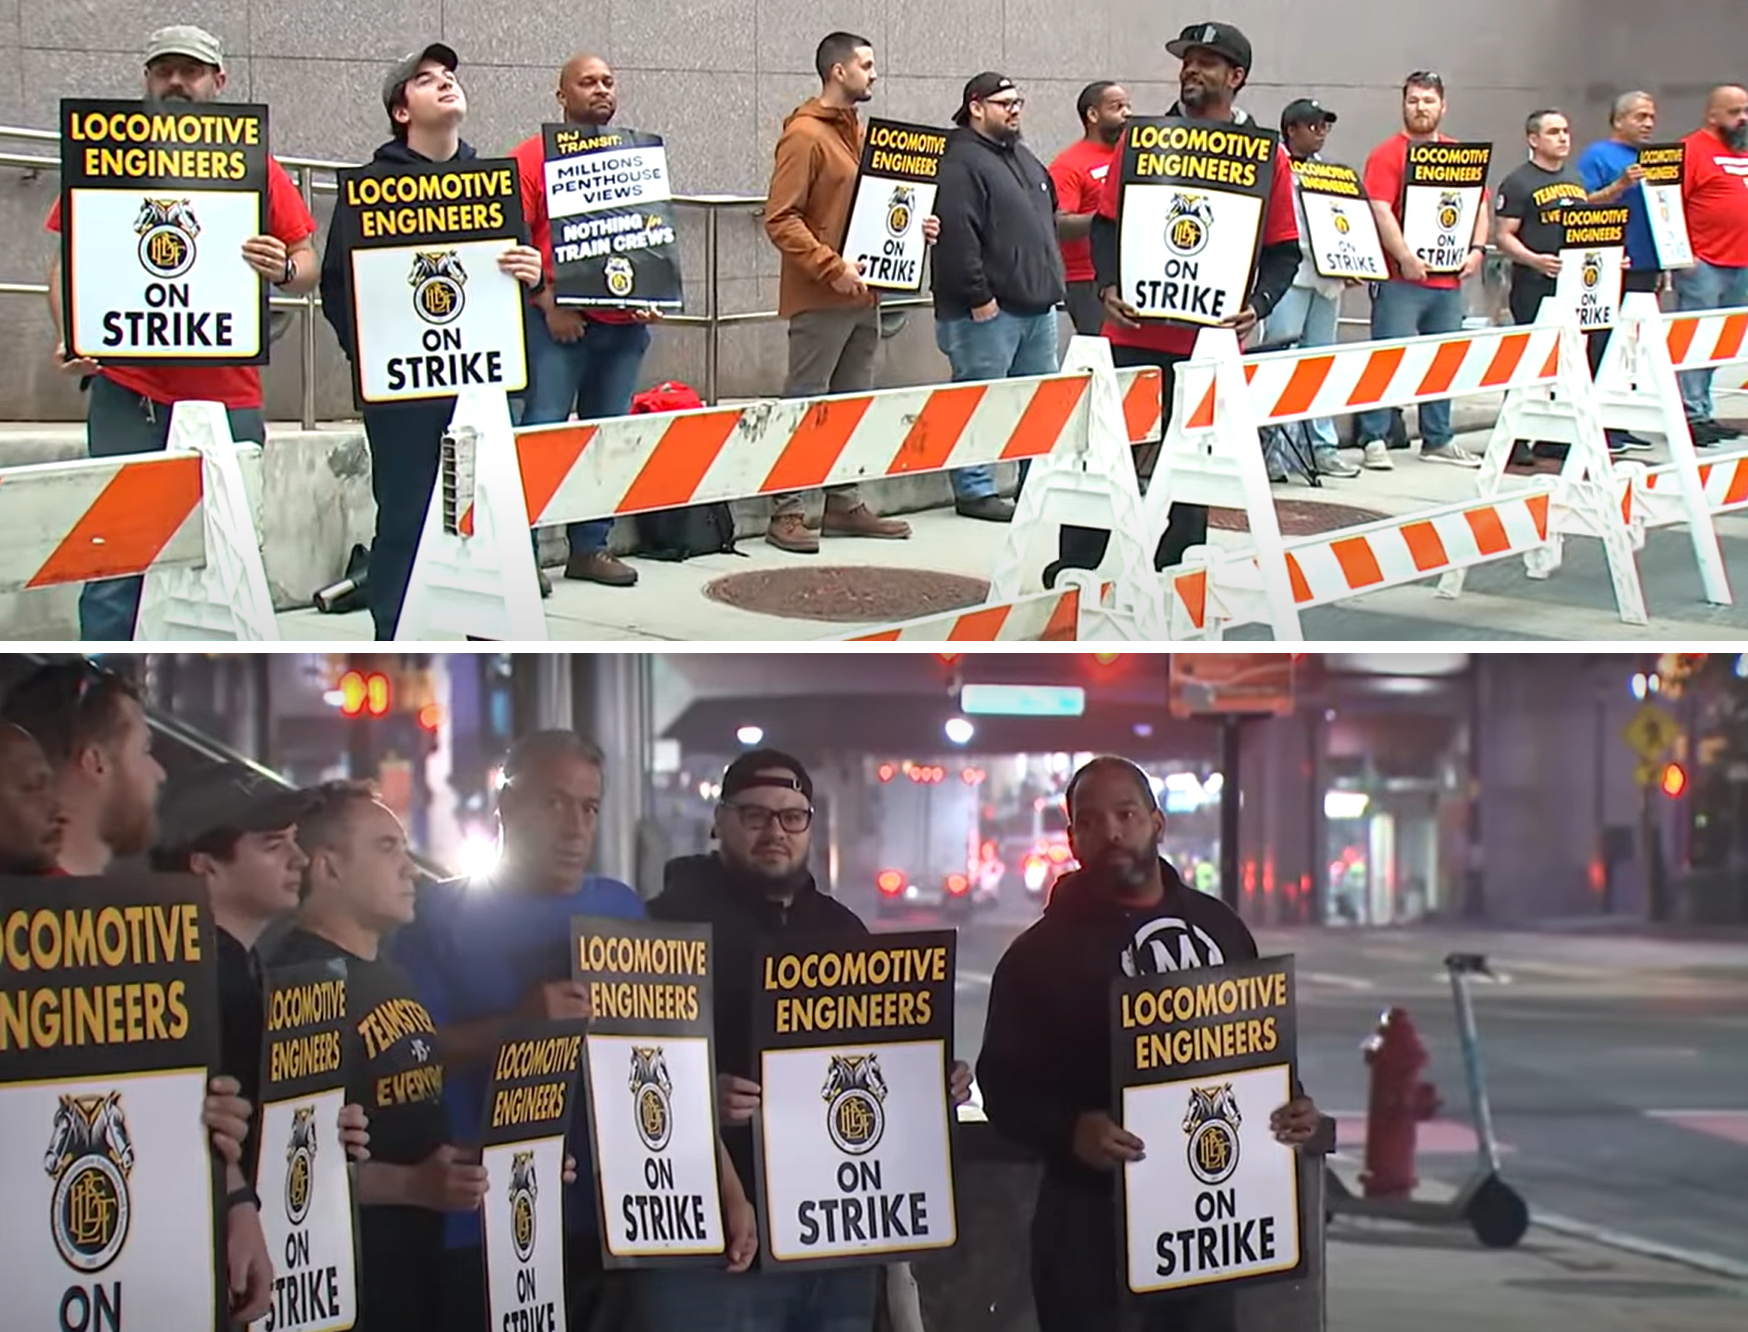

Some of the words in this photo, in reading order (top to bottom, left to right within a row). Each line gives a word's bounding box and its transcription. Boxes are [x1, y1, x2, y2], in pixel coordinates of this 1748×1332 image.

[71, 113, 259, 145] LOCOMOTIVE
[557, 130, 579, 142] NJ
[559, 135, 622, 154] TRANSIT:
[870, 127, 947, 155] LOCOMOTIVE
[1130, 126, 1271, 161] LOCOMOTIVE
[85, 148, 247, 180] ENGINEERS
[557, 155, 643, 179] MILLIONS
[871, 151, 938, 176] ENGINEERS
[1136, 153, 1256, 187] ENGINEERS
[1410, 147, 1490, 164] LOCOMOTIVE
[347, 170, 513, 206] LOCOMOTIVE
[552, 168, 661, 195] PENTHOUSE
[1415, 165, 1483, 181] ENGINEERS
[583, 184, 643, 204] VIEWS
[362, 203, 504, 238] ENGINEERS
[563, 213, 643, 242] NOTHING
[1562, 209, 1629, 226] LOCOMOTIVE
[1566, 226, 1622, 243] ENGINEERS
[555, 239, 611, 263] TRAIN
[613, 227, 674, 252] CREWS
[883, 239, 905, 256] ON
[1437, 234, 1456, 247] ON
[857, 253, 916, 283] STRIKE
[1165, 259, 1198, 280] ON
[1326, 253, 1377, 273] STRIKE
[144, 283, 189, 308] ON
[1135, 280, 1226, 317] STRIKE
[1581, 294, 1597, 306] ON
[102, 311, 233, 347] STRIKE
[1575, 306, 1610, 325] RIKE
[422, 327, 461, 352] ON
[387, 351, 503, 391] STRIKE
[0, 904, 201, 971] COMOTIVE
[580, 936, 706, 976] LOCOMOTIVE
[764, 947, 946, 990] LOCOMOTIVE
[268, 980, 346, 1031] LOCOMOTIVE
[590, 981, 699, 1021] ENGINEERS
[776, 990, 932, 1033] ENGINEERS
[1122, 973, 1287, 1028] LOCOMOTIVE
[271, 1030, 340, 1082] ENGINEERS
[495, 1036, 581, 1082] LOCOMOTIVE
[1135, 1017, 1277, 1069] ENGINEERS
[493, 1082, 567, 1127] ENGINEERS
[644, 1157, 674, 1190] ON
[837, 1160, 881, 1193] ON
[622, 1194, 707, 1242] STRIKE
[798, 1192, 929, 1246] STRIKE
[1194, 1187, 1236, 1222] ON
[285, 1230, 310, 1270] ON
[1155, 1216, 1275, 1276] STRIKE
[516, 1268, 537, 1304] ON
[59, 1281, 122, 1332] ON
